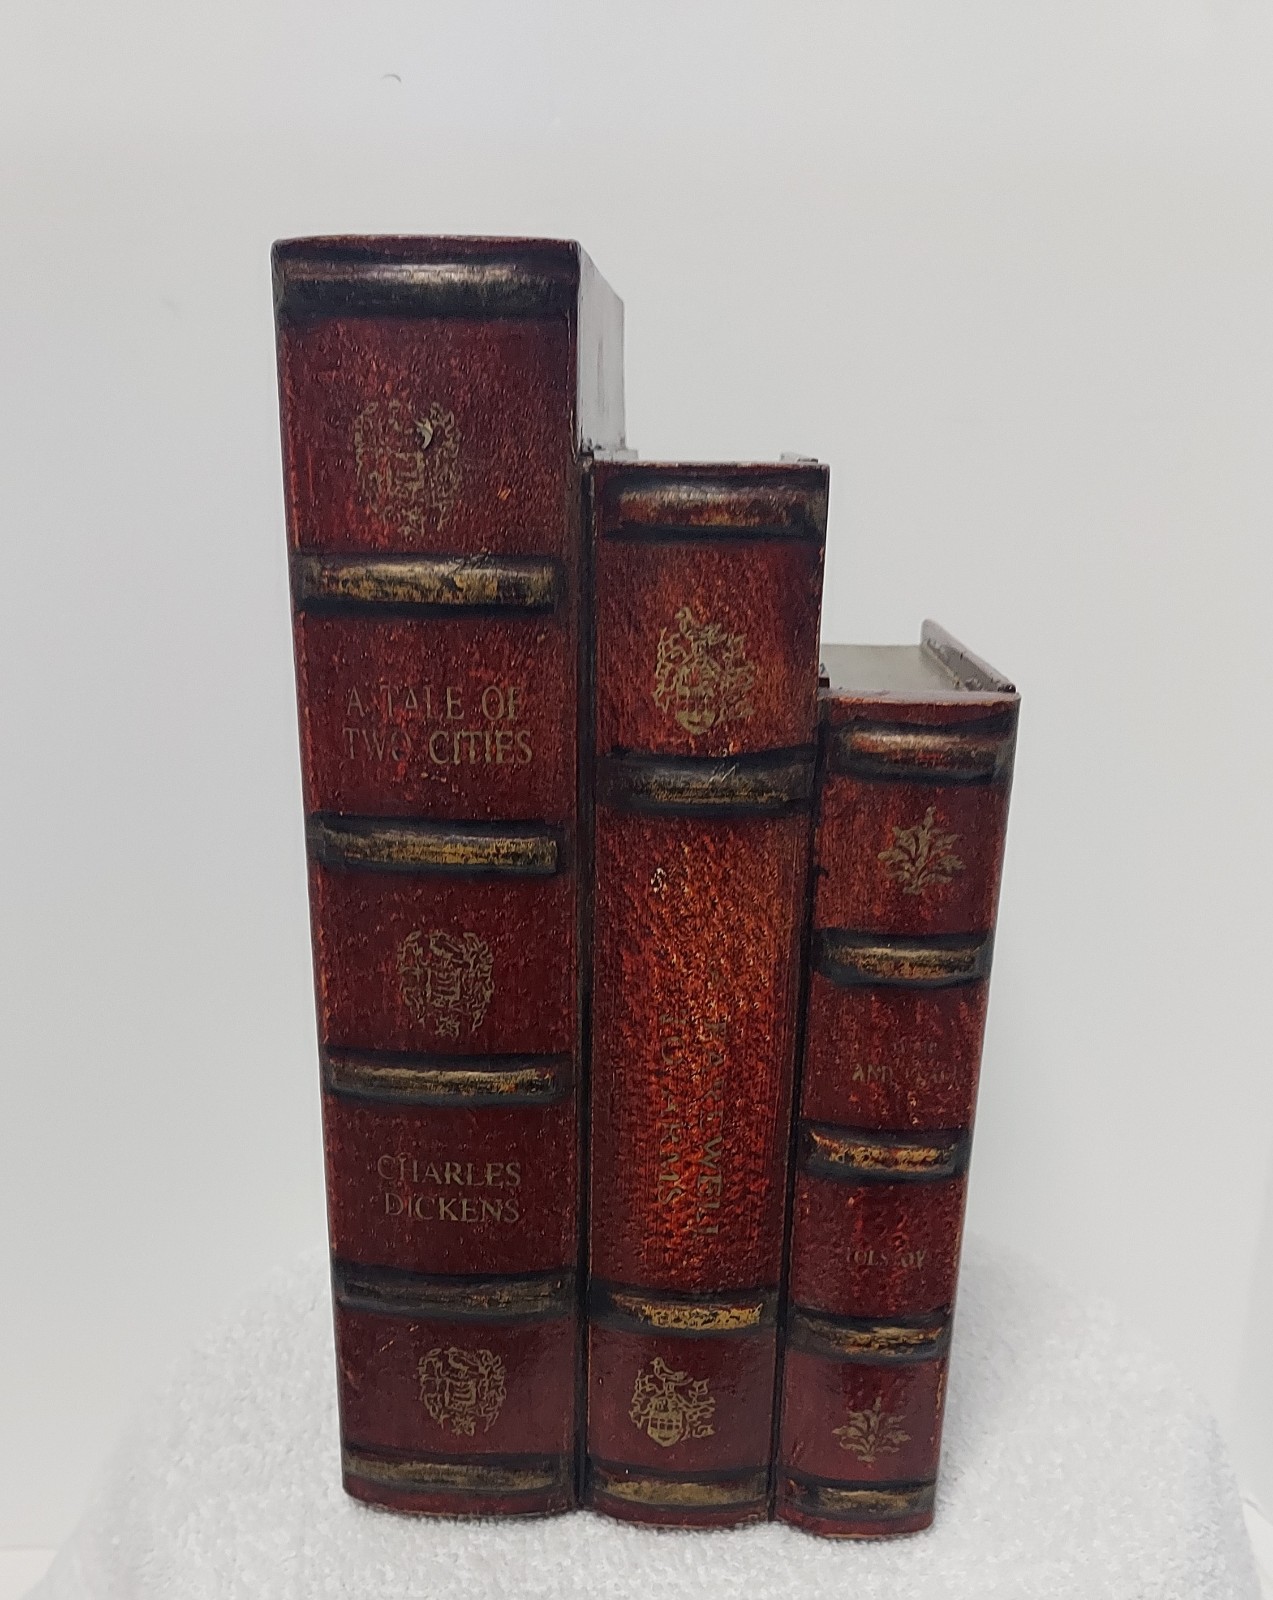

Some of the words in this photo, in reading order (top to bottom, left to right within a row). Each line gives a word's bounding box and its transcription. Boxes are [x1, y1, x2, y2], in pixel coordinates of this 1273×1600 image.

[346, 684, 365, 718] A
[343, 727, 412, 762] TWO
[428, 729, 533, 765] CITIES
[377, 1153, 521, 1187] CHARLES
[385, 1192, 520, 1224] DICKENS
